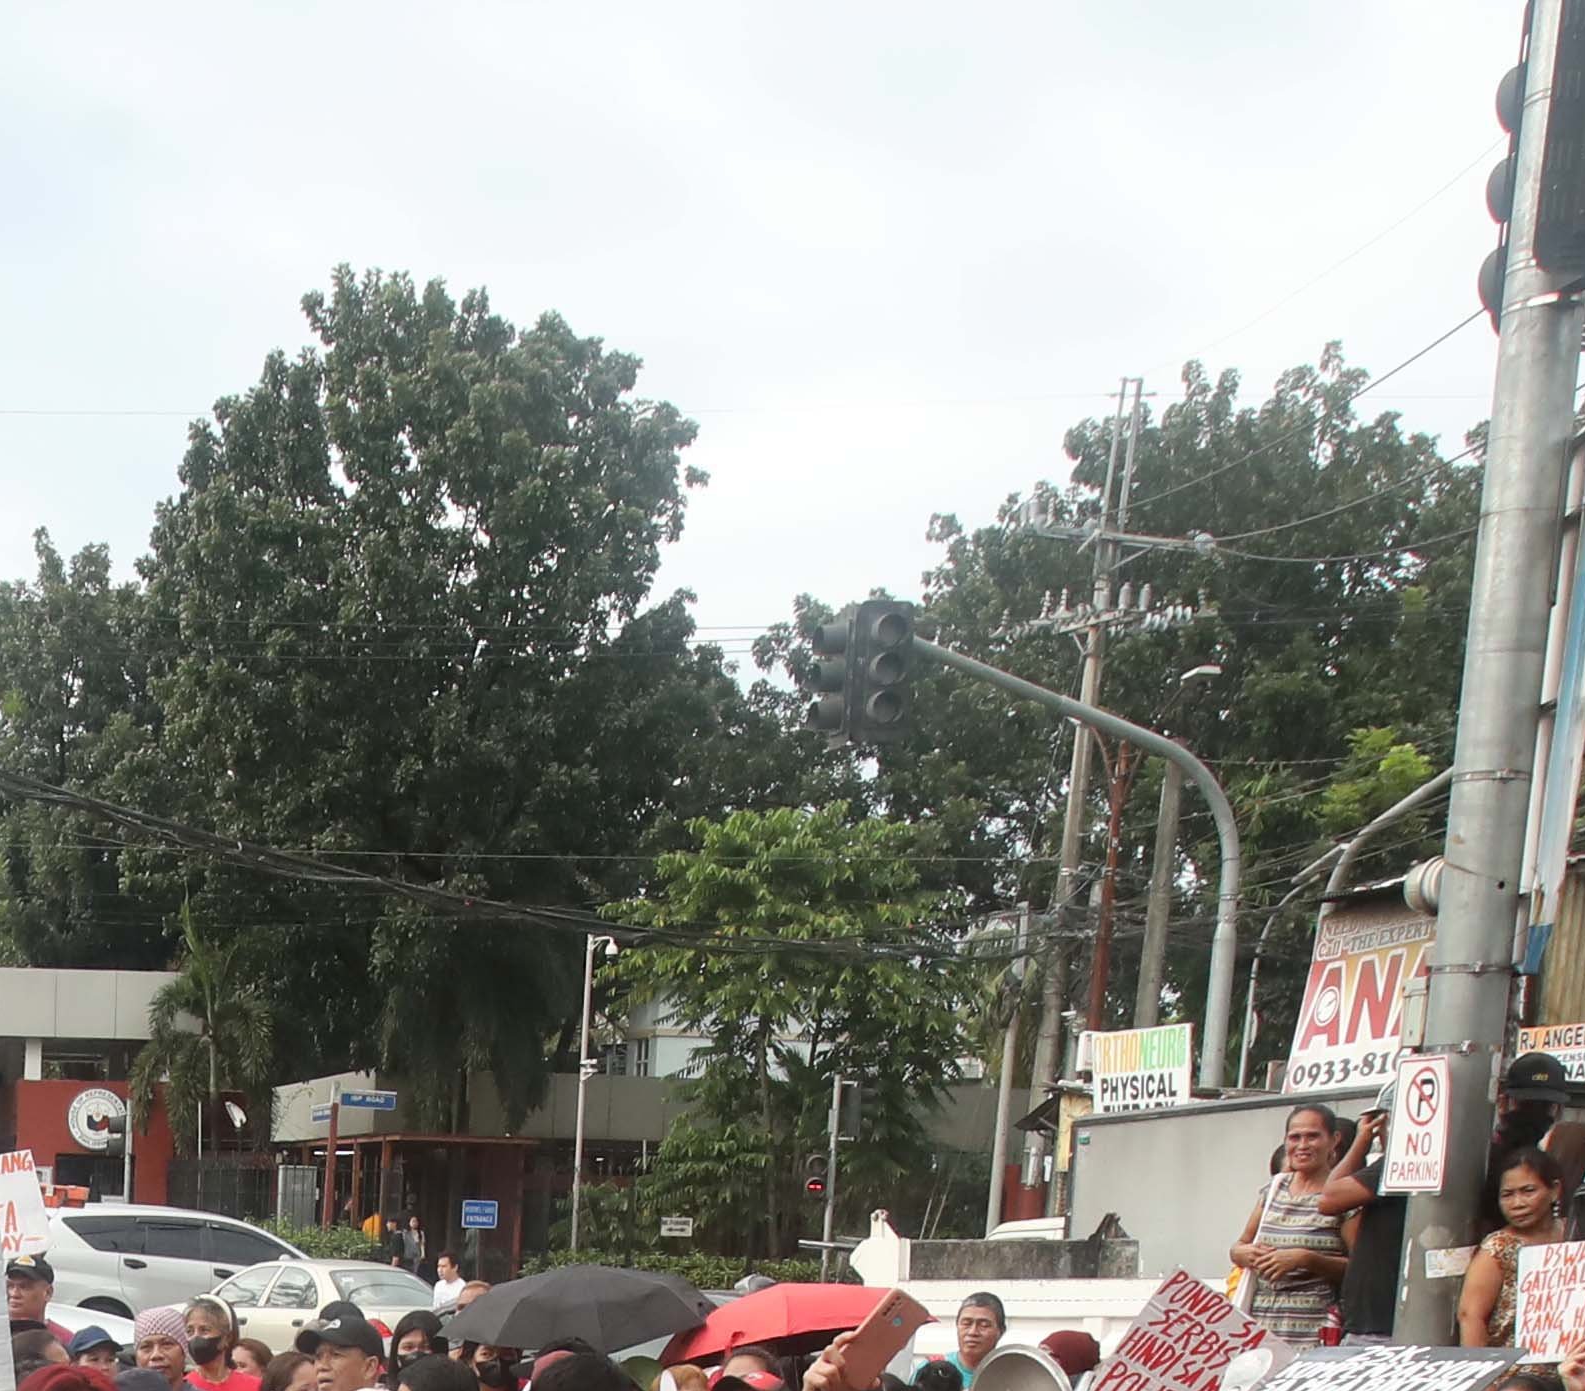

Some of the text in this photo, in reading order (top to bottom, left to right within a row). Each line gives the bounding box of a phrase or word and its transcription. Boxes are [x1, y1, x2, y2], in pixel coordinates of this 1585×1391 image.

[1520, 1032, 1537, 1050] RJ
[1292, 1052, 1398, 1087] 0933-81
[1101, 1073, 1176, 1102] PHYSICAL
[1405, 1132, 1432, 1156] NO
[1390, 1161, 1438, 1182] PARKING
[1158, 1271, 1267, 1353] PONDO SA
[1524, 1288, 1576, 1316] BAKIT
[1520, 1311, 1565, 1335] KANG
[1116, 1327, 1204, 1387] HINDI SA
